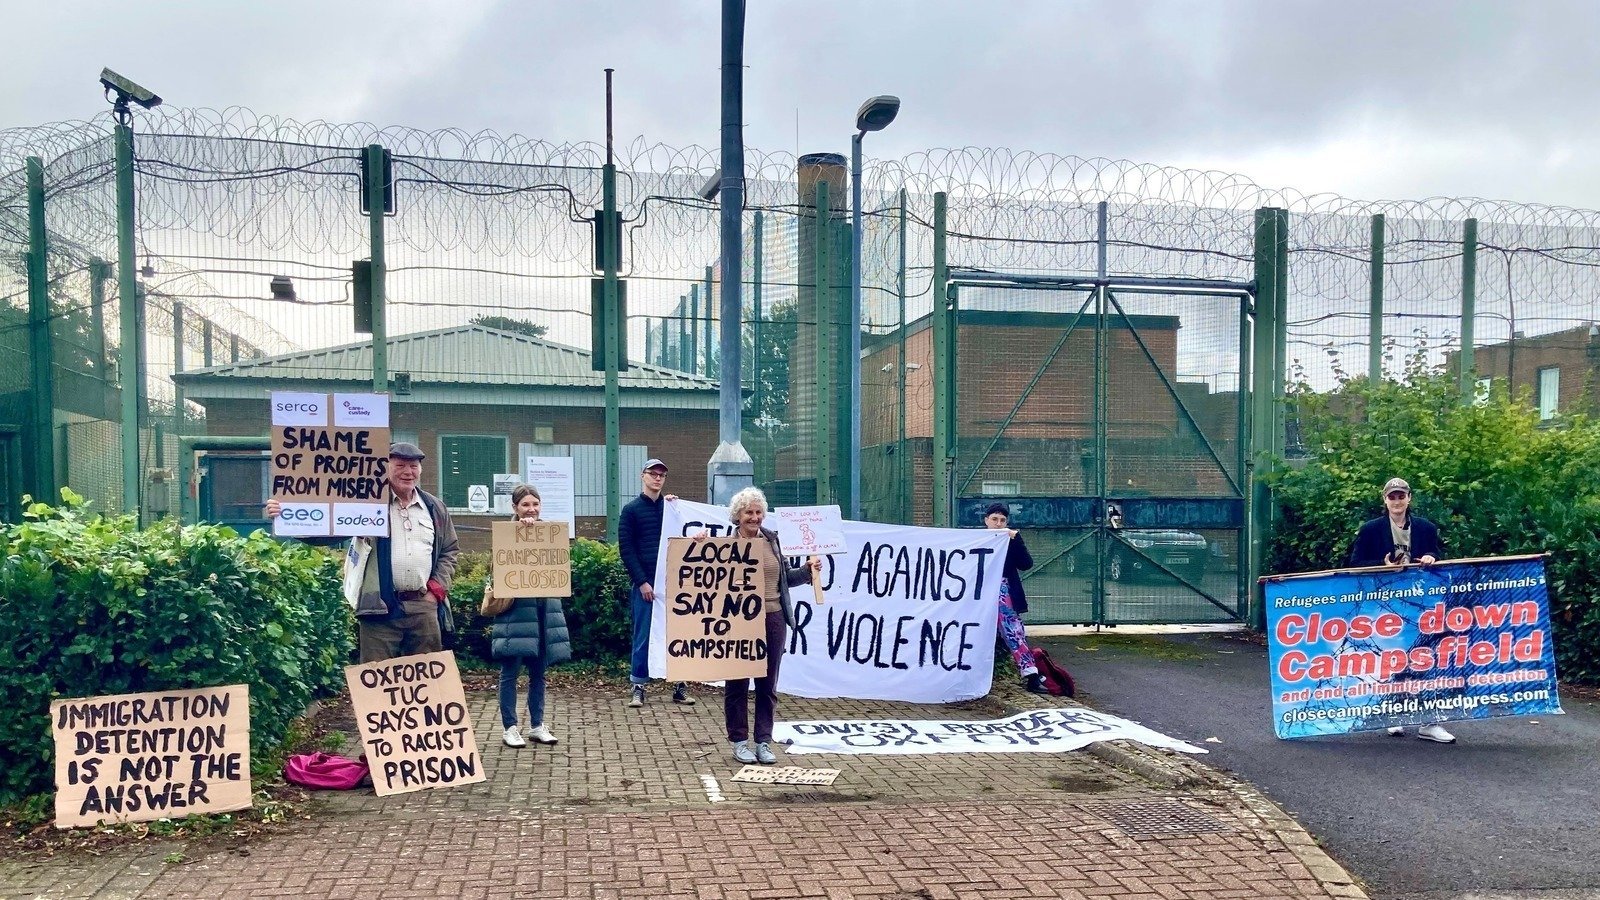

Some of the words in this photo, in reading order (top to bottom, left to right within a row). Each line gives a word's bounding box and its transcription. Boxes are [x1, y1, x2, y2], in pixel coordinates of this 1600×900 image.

[276, 402, 318, 413] serco
[283, 427, 373, 454] SHAME
[275, 453, 303, 470] OF
[314, 454, 389, 477] PROFITS
[273, 475, 320, 495] FROM
[326, 477, 389, 499] MISERY
[336, 513, 385, 526] sodexo
[515, 525, 561, 544] KEEP
[496, 548, 569, 566] CAMPSFIELD
[682, 541, 759, 566] LOCAL
[504, 570, 569, 589] CLOSED
[679, 566, 757, 593] PEOPLE
[852, 541, 994, 601] AGAINST
[672, 592, 717, 615] SAY
[722, 593, 762, 621] NO
[1274, 595, 1336, 608] Refugees
[1340, 591, 1363, 603] and
[1366, 585, 1425, 602] migrants
[1428, 585, 1447, 596] are
[1450, 582, 1472, 593] not
[1475, 577, 1537, 591] criminals
[701, 617, 731, 636] TO
[1275, 612, 1404, 646] Close
[1418, 600, 1539, 634] down
[668, 638, 767, 661] CAMPSFIELD
[827, 607, 980, 671] VIOLENCE
[1278, 630, 1544, 682] Campsfield
[360, 660, 446, 688] OXFORD
[1281, 688, 1310, 702] and
[1314, 686, 1343, 700] end
[1347, 683, 1367, 696] all
[1372, 676, 1465, 694] immigration
[1468, 669, 1548, 686] detention
[383, 684, 429, 706] TUC
[1282, 689, 1549, 723] closecampsfield.wordpress.com
[57, 692, 229, 730] IMMIGRATION
[366, 707, 419, 734] SAYS
[424, 702, 465, 726] NO
[74, 724, 226, 756] DETENTION
[367, 738, 393, 758] TO
[402, 728, 468, 753] RACIST
[840, 721, 1112, 746] OXFORD
[67, 757, 103, 785] IS
[119, 755, 181, 782] NOT
[190, 753, 241, 781] THE
[384, 752, 476, 789] PRISON
[79, 779, 210, 816] ANSWER
